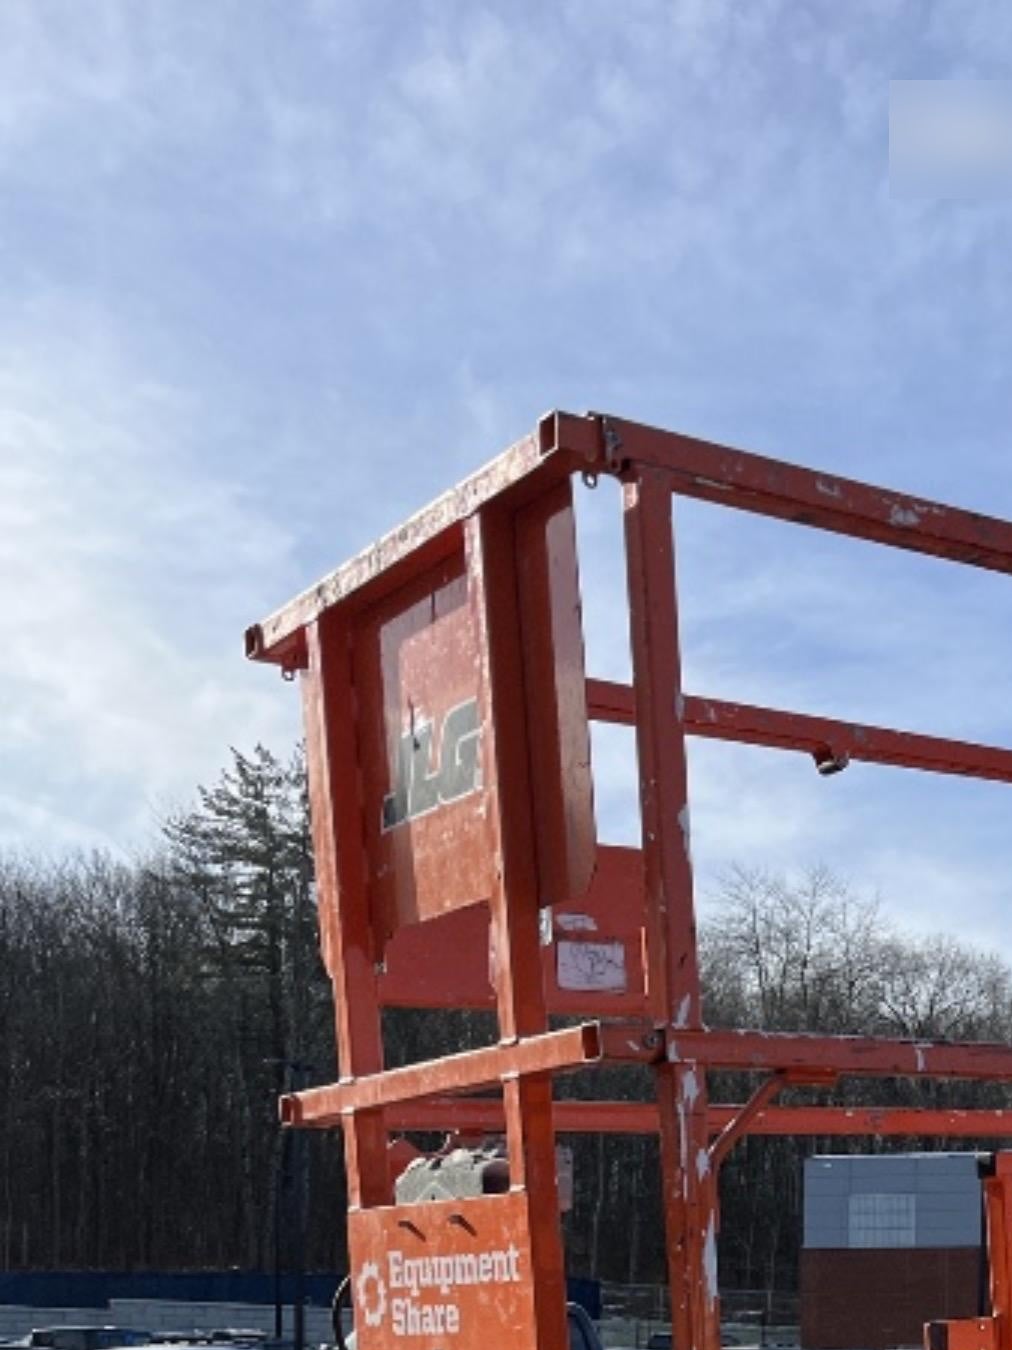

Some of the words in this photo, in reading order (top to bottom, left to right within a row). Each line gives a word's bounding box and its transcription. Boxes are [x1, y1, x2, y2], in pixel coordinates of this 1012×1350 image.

[382, 698, 482, 833] JLG
[388, 1243, 521, 1297] Equipment
[391, 1298, 460, 1336] Share
